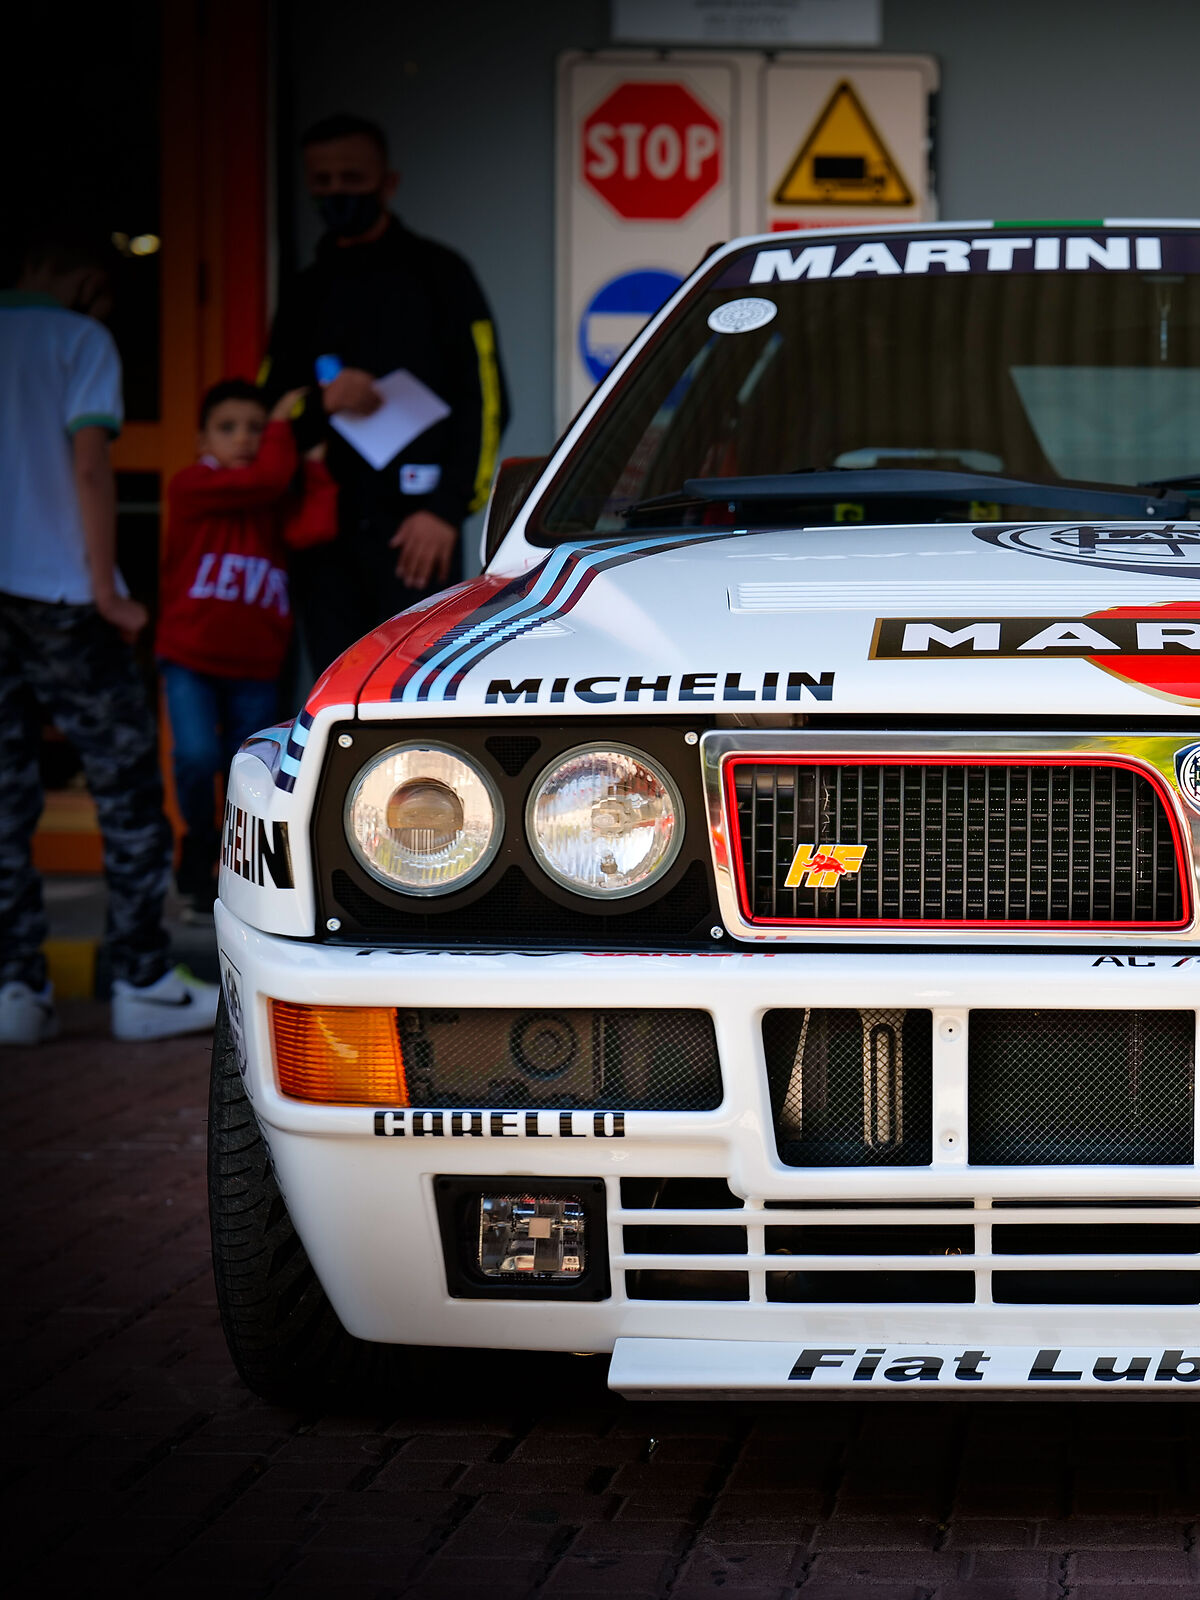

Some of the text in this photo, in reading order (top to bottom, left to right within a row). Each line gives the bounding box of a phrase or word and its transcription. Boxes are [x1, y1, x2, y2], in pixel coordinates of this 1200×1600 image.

[586, 122, 718, 181] STOP
[749, 236, 1163, 284] MARTINI
[484, 671, 836, 704] MICHELIN
[783, 843, 868, 888] HF
[373, 1110, 625, 1137] CARELLO
[787, 1348, 991, 1382] Fiat
